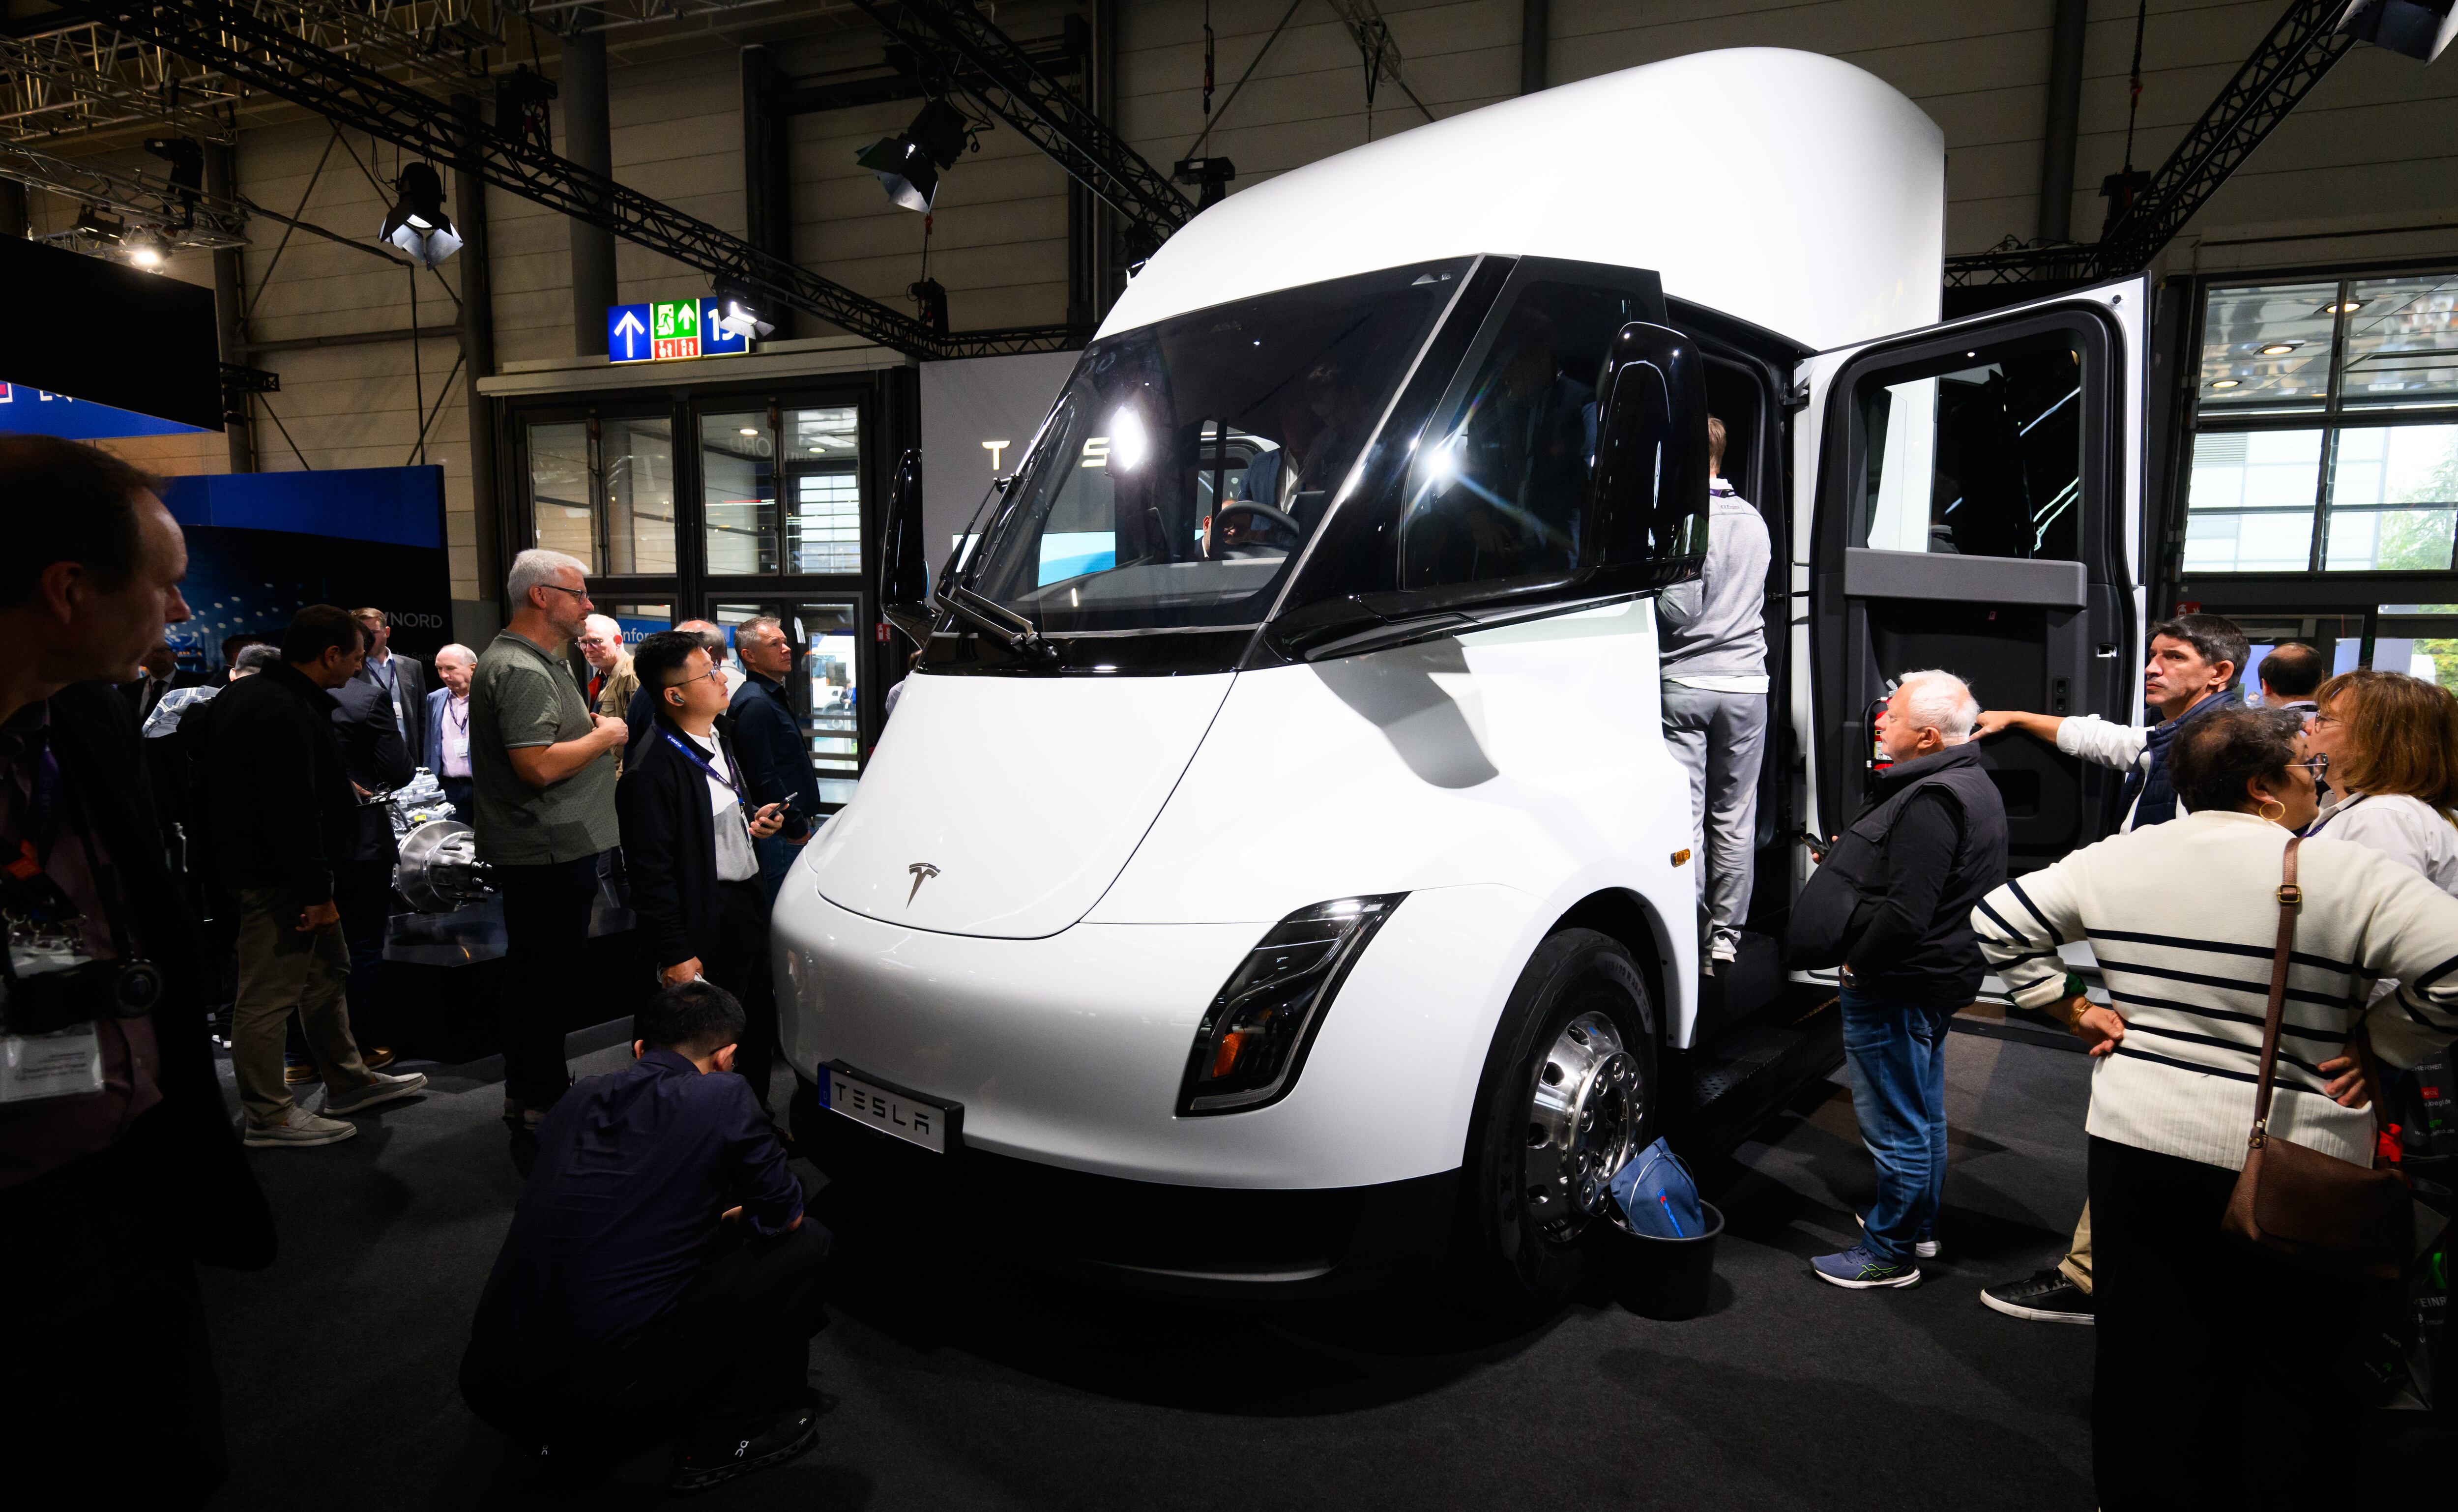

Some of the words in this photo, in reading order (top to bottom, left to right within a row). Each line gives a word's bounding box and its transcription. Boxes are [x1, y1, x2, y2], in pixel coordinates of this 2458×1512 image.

[623, 627, 654, 641] nfor
[671, 737, 682, 748] VARTA
[696, 757, 711, 771] CLARIOS
[823, 1090, 828, 1100] D
[835, 1081, 930, 1135] TESLA
